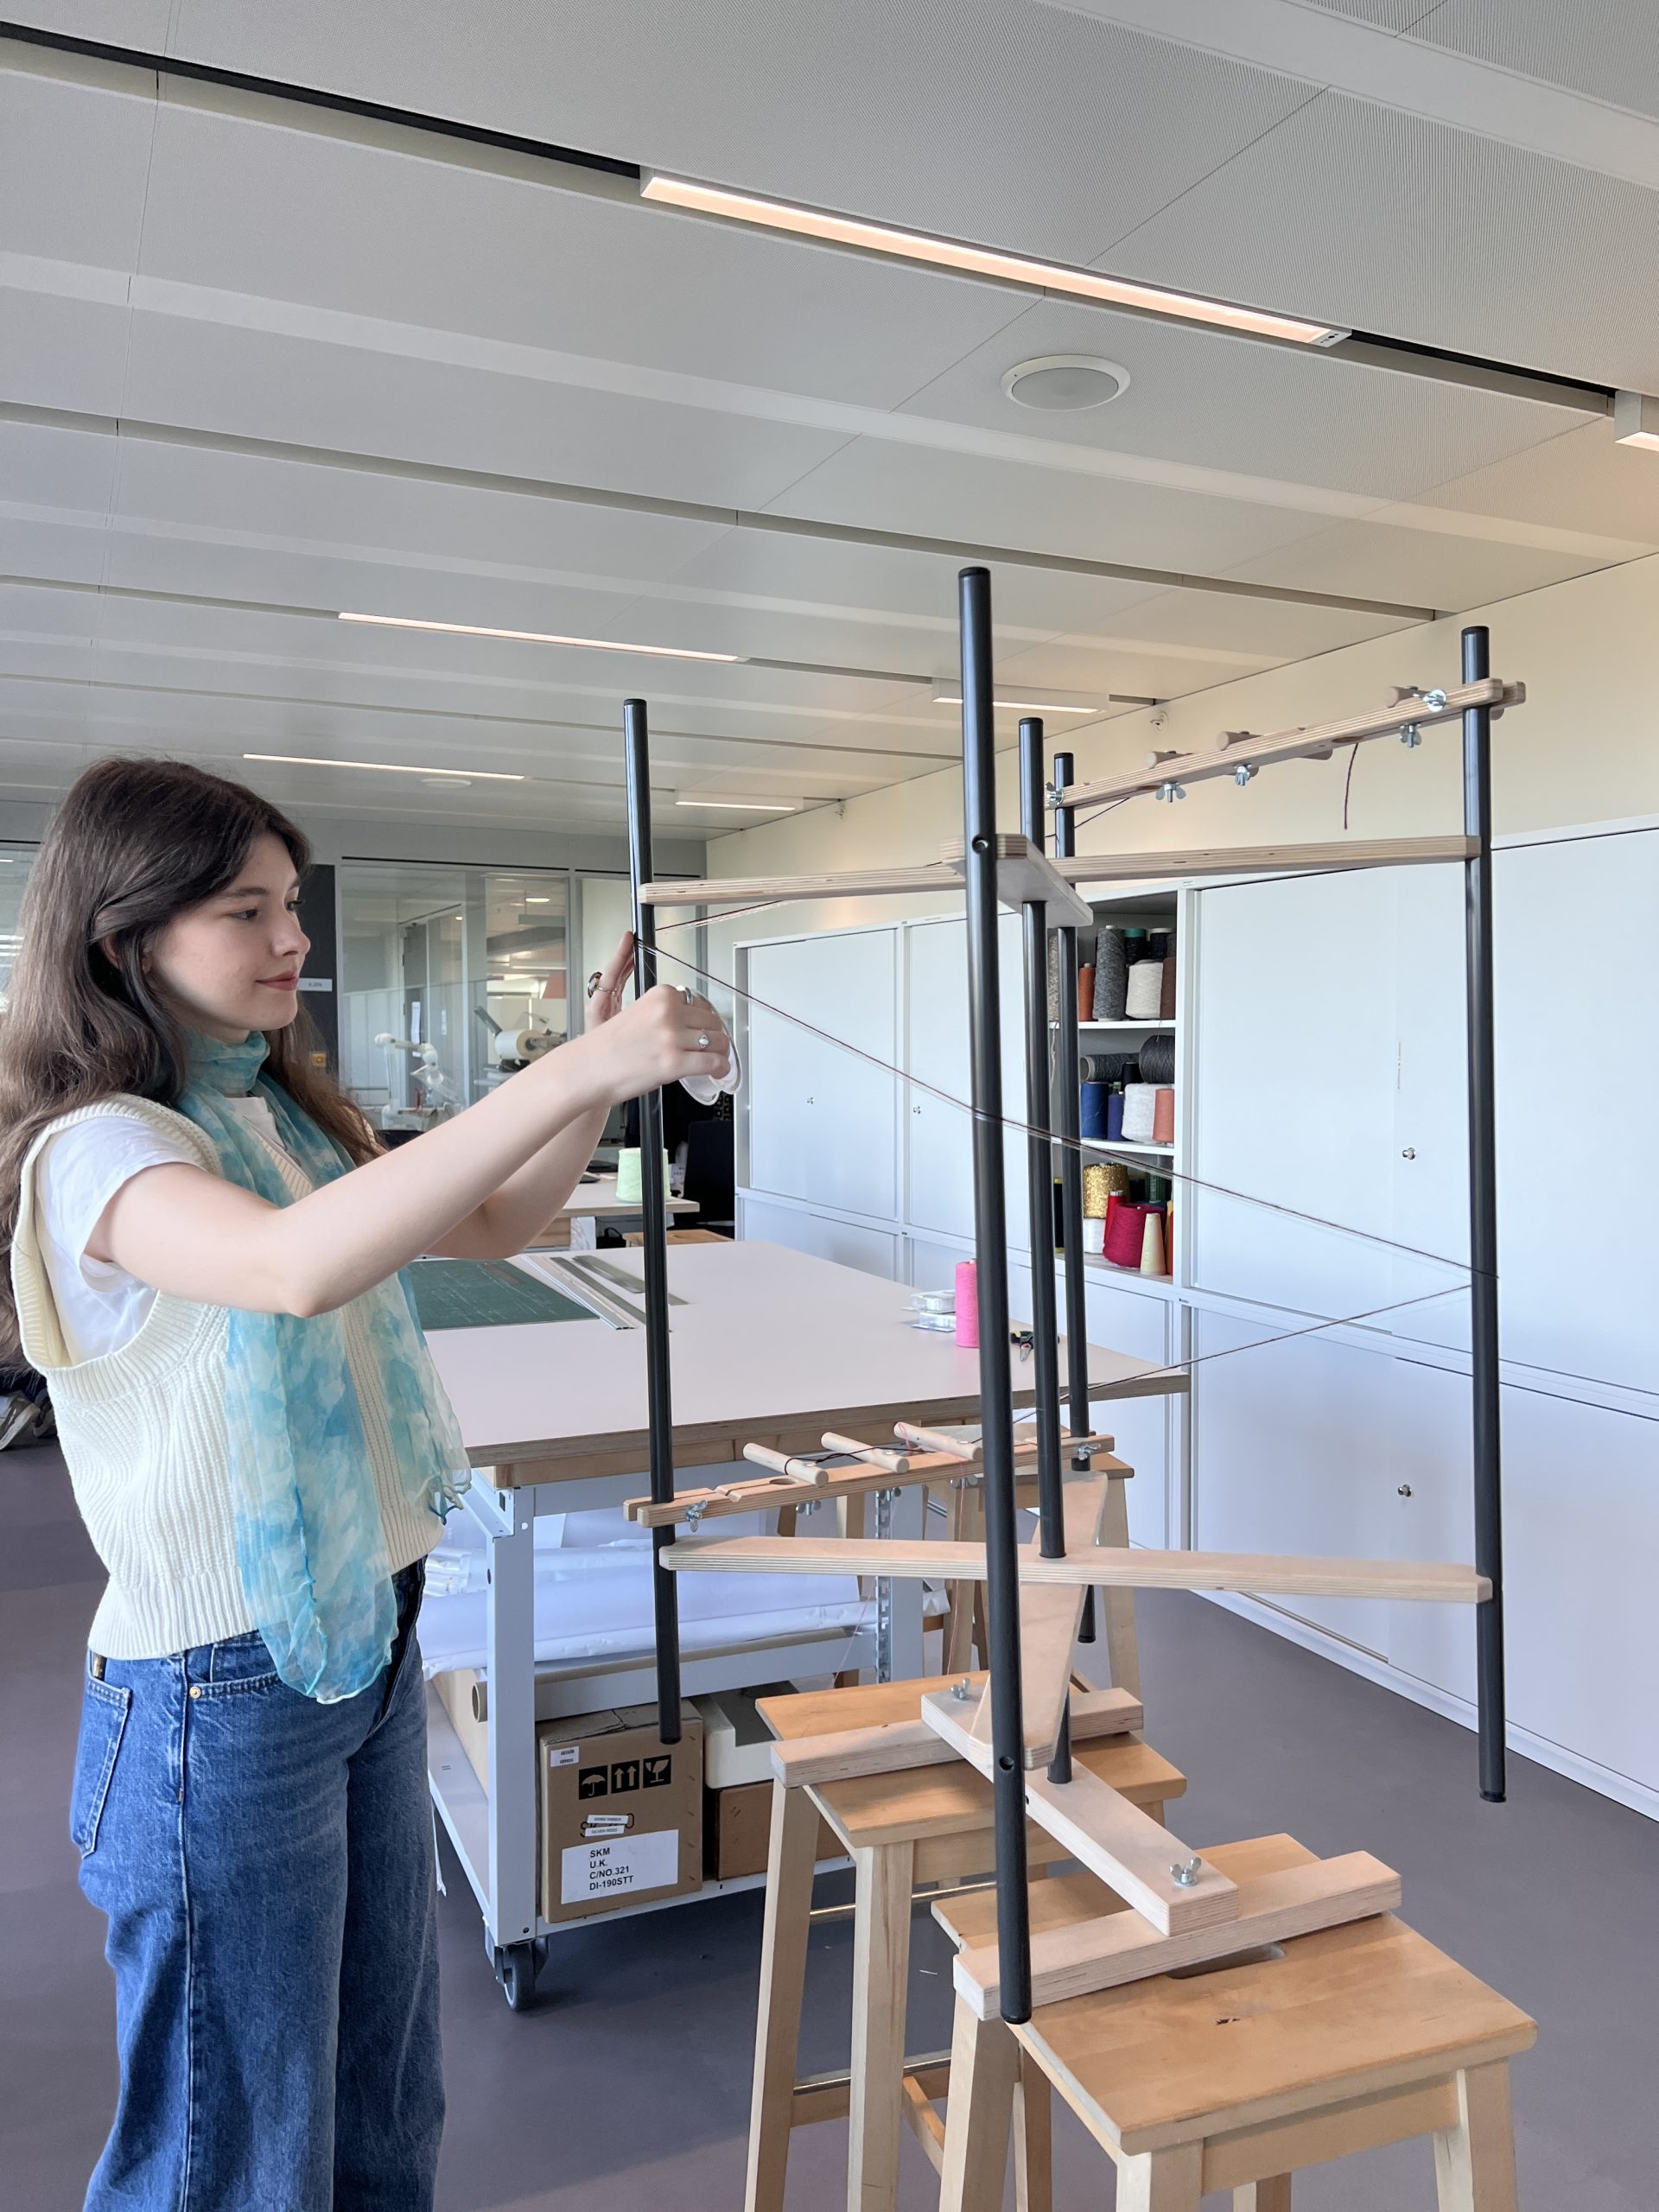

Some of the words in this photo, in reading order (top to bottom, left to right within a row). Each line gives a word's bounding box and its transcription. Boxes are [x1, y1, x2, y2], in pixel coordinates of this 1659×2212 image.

[589, 1847, 610, 1858] SKM
[589, 1859, 607, 1869] U.K.
[589, 1866, 629, 1879] C/NO.321
[589, 1875, 633, 1891] DI-190STT
